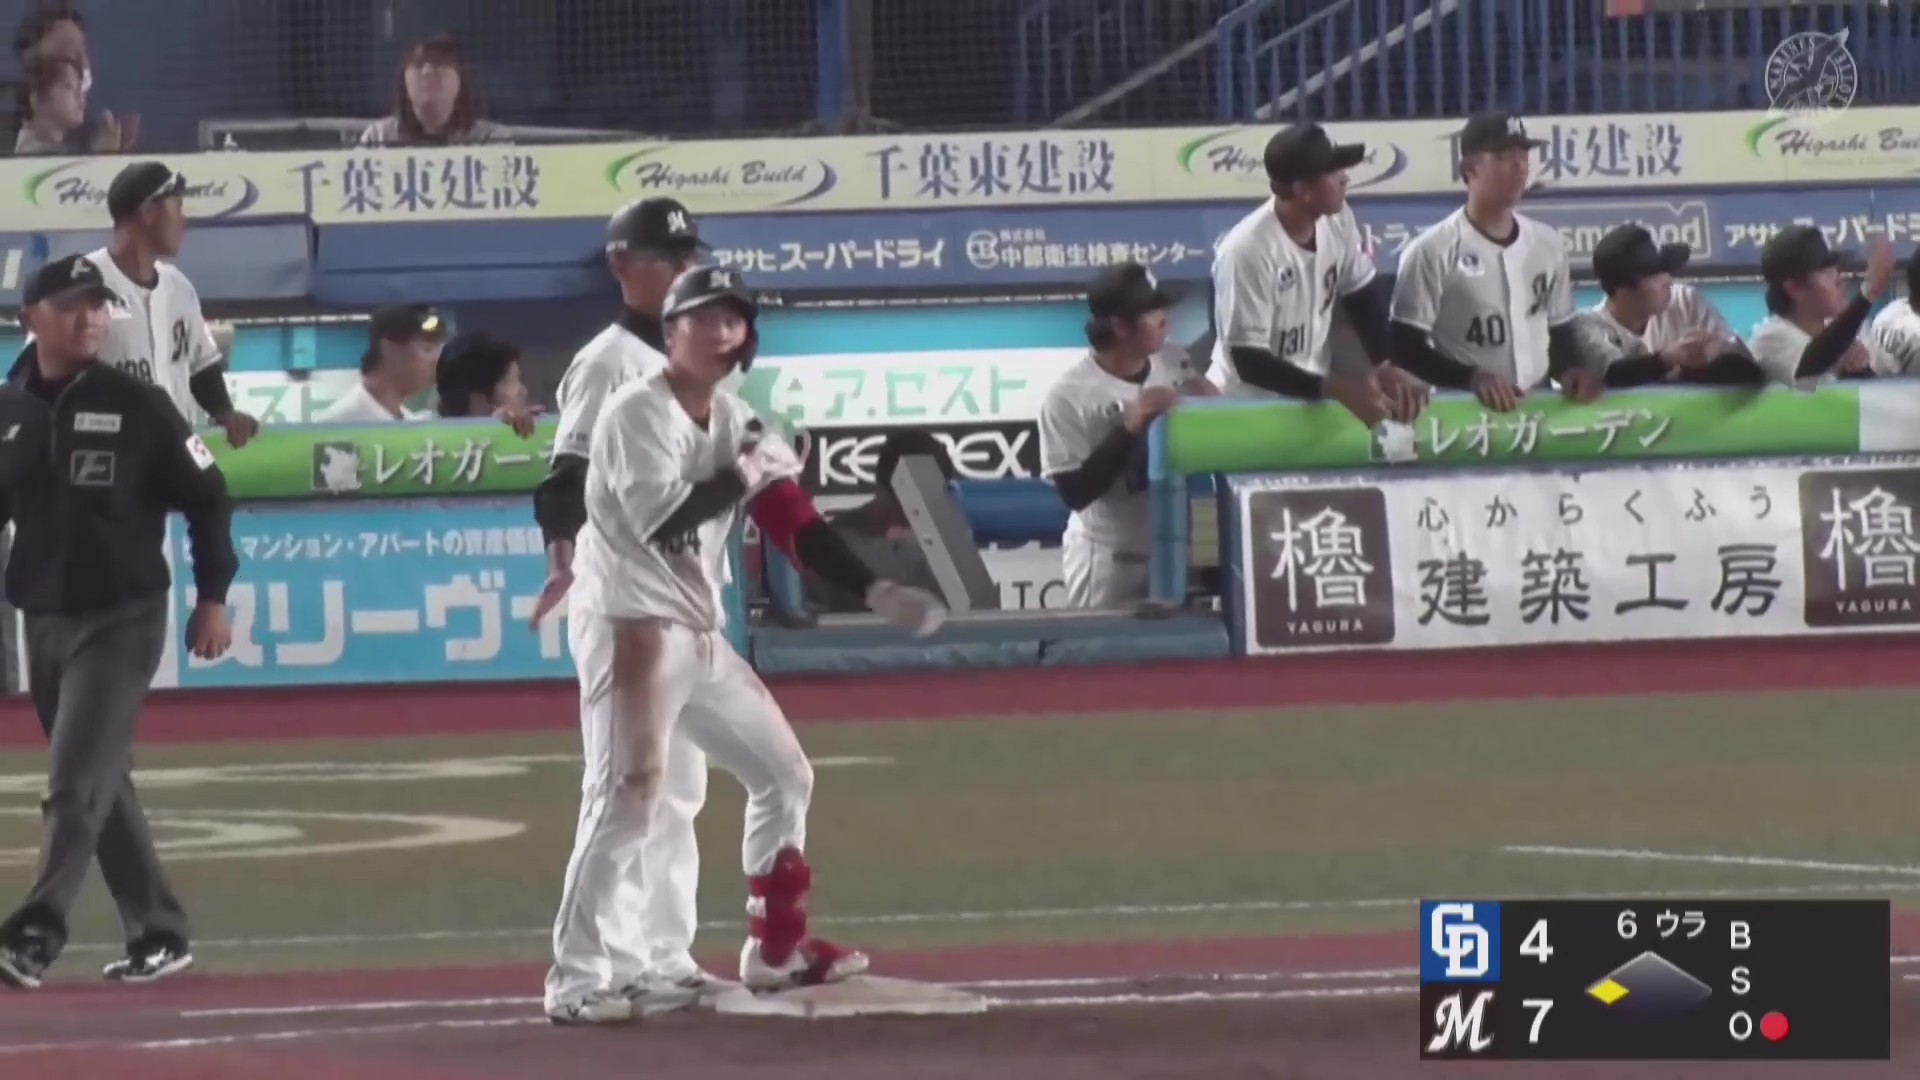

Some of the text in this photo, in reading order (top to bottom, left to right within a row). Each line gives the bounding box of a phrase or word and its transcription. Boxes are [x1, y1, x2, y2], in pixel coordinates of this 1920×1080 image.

[1775, 130, 1867, 156] Higashi
[288, 154, 540, 214] 千葉東建設
[635, 160, 807, 189] Higashi Build
[866, 139, 1115, 200] 千葉東建設
[1466, 315, 1506, 347] 40
[1429, 408, 1672, 457] レオガーデン
[1417, 485, 1773, 532] 心からくふう
[1270, 505, 1375, 613] 櫓
[1417, 543, 1783, 626] 建築工房
[1835, 598, 1912, 613] YAGURA
[1287, 618, 1364, 635] YAGURA
